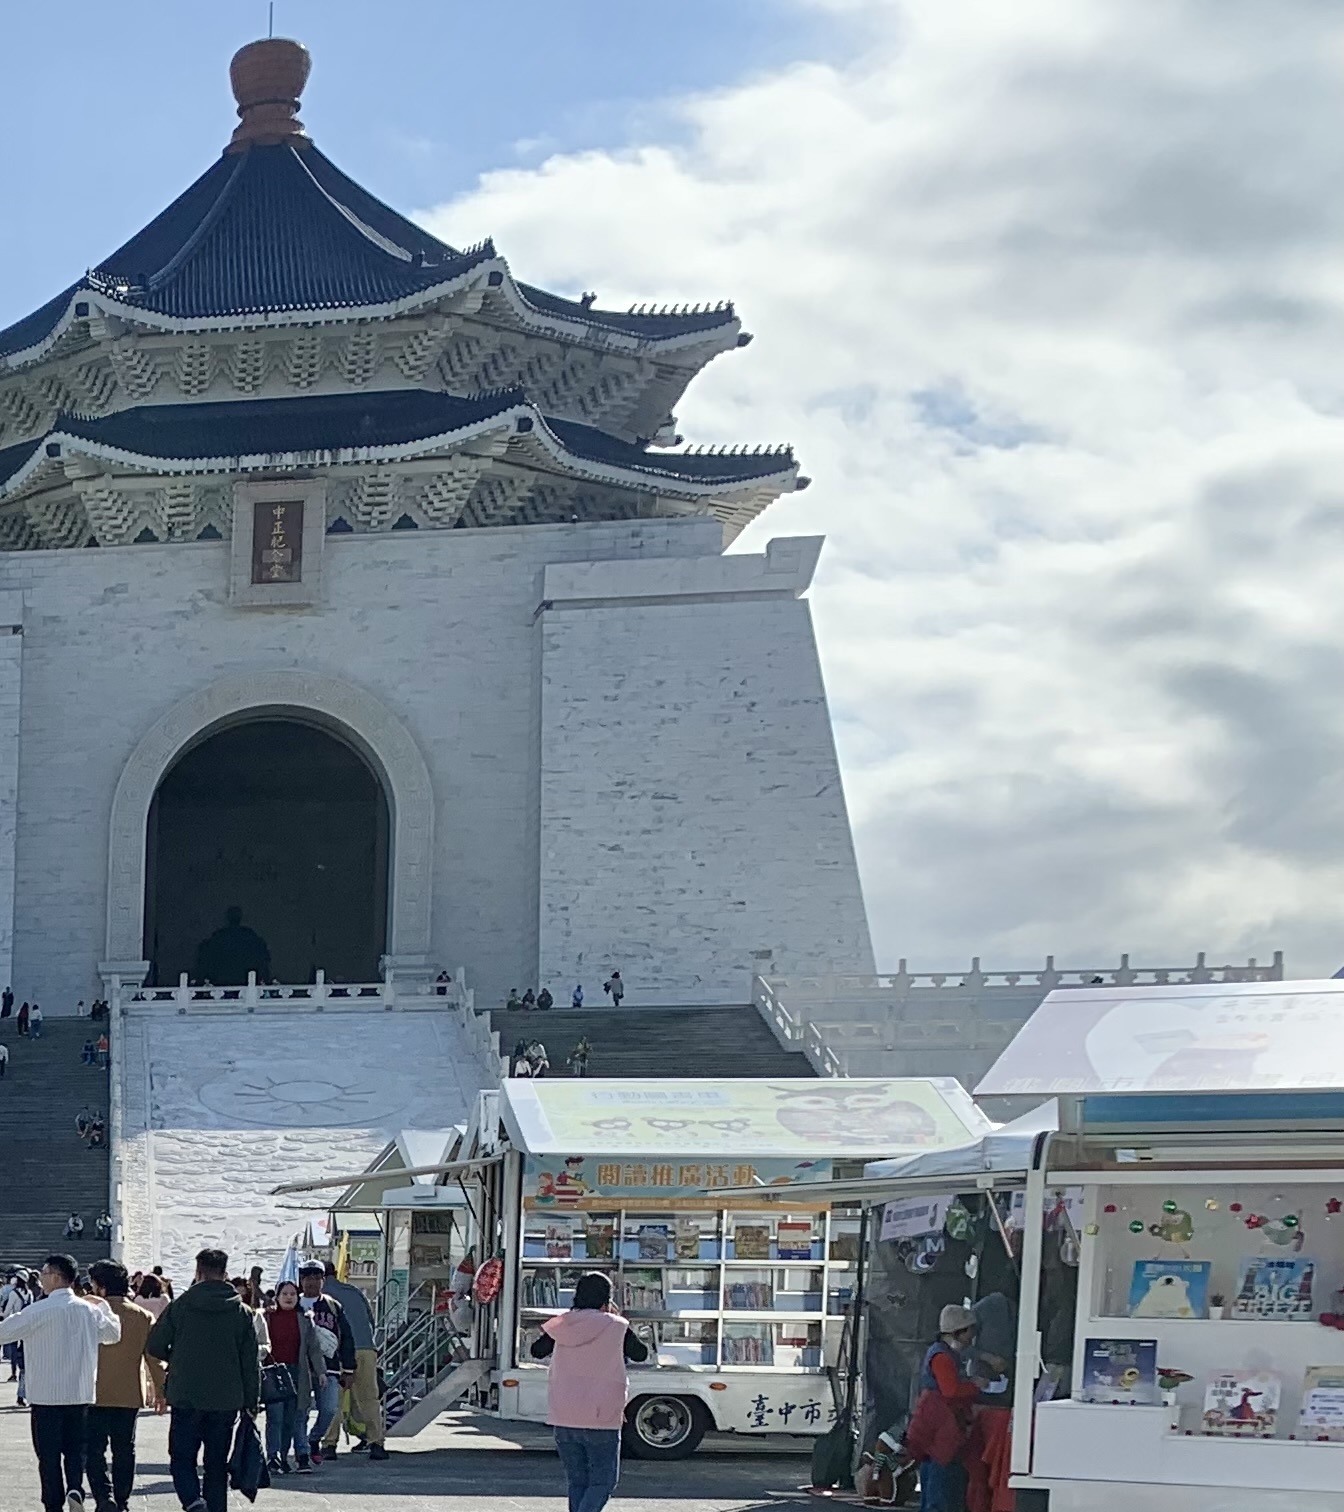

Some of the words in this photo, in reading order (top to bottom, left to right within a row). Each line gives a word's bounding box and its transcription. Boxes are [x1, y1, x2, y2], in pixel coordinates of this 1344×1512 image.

[270, 504, 287, 578] 中正紀念堂
[596, 1163, 758, 1187] 閱讀推廣活動
